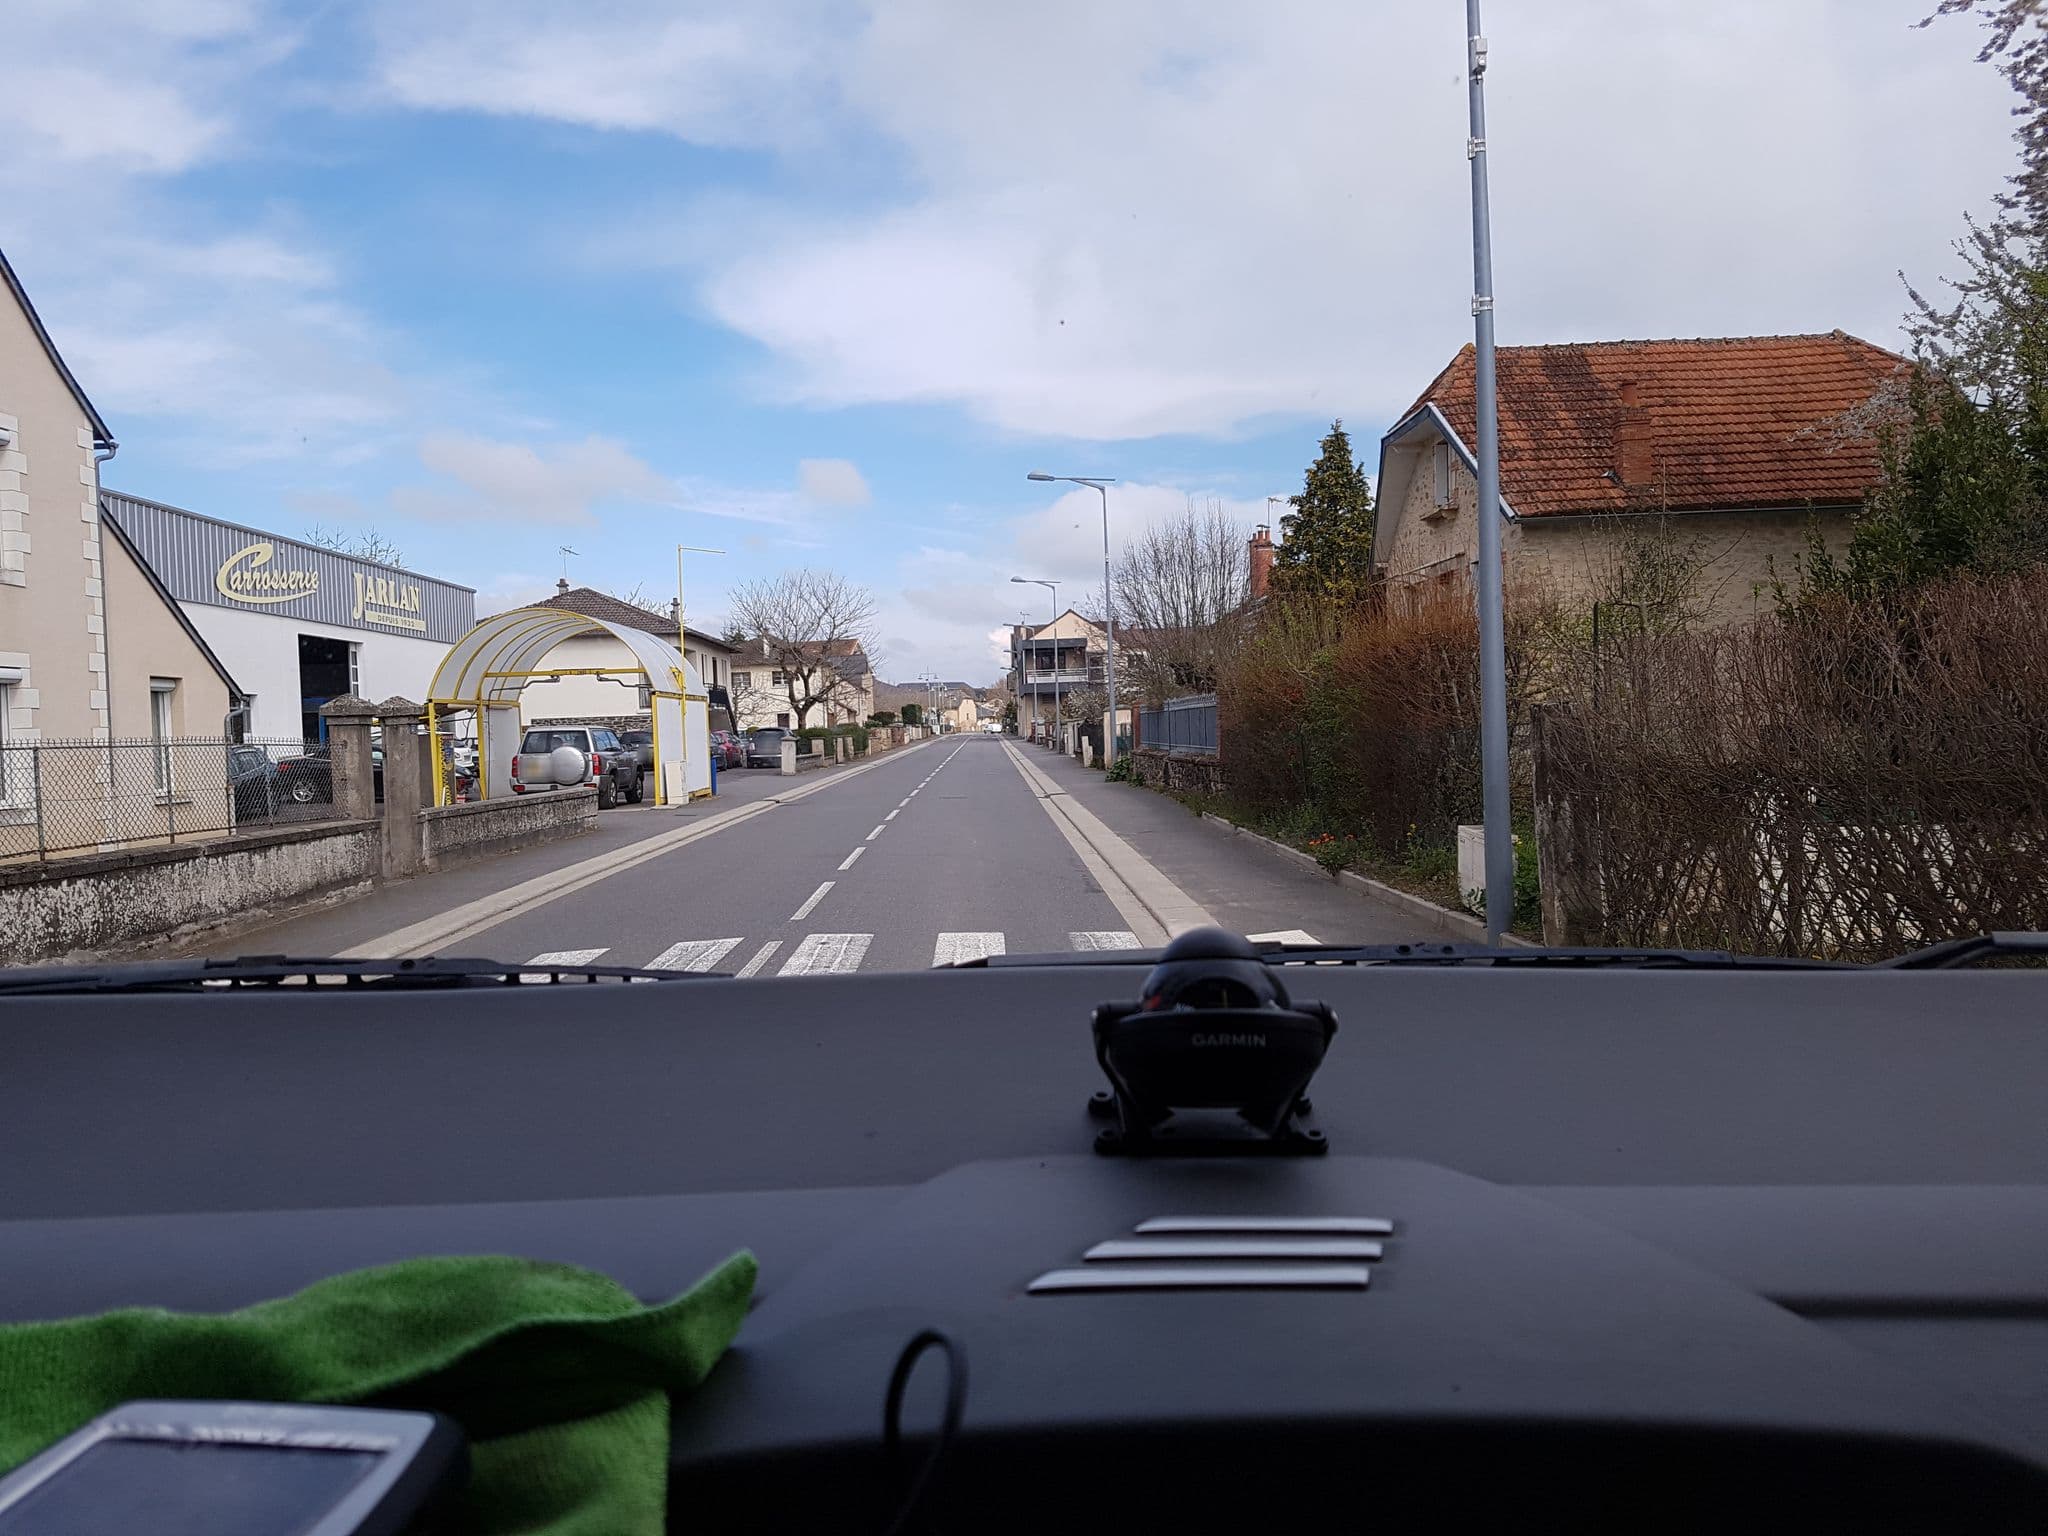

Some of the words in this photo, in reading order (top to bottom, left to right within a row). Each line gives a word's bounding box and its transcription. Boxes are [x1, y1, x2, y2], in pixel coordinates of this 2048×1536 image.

[216, 542, 319, 603] Carrosserie
[353, 572, 419, 620] JARLAN
[377, 614, 399, 625] DEPUIS
[1191, 1033, 1267, 1047] GARMIN
